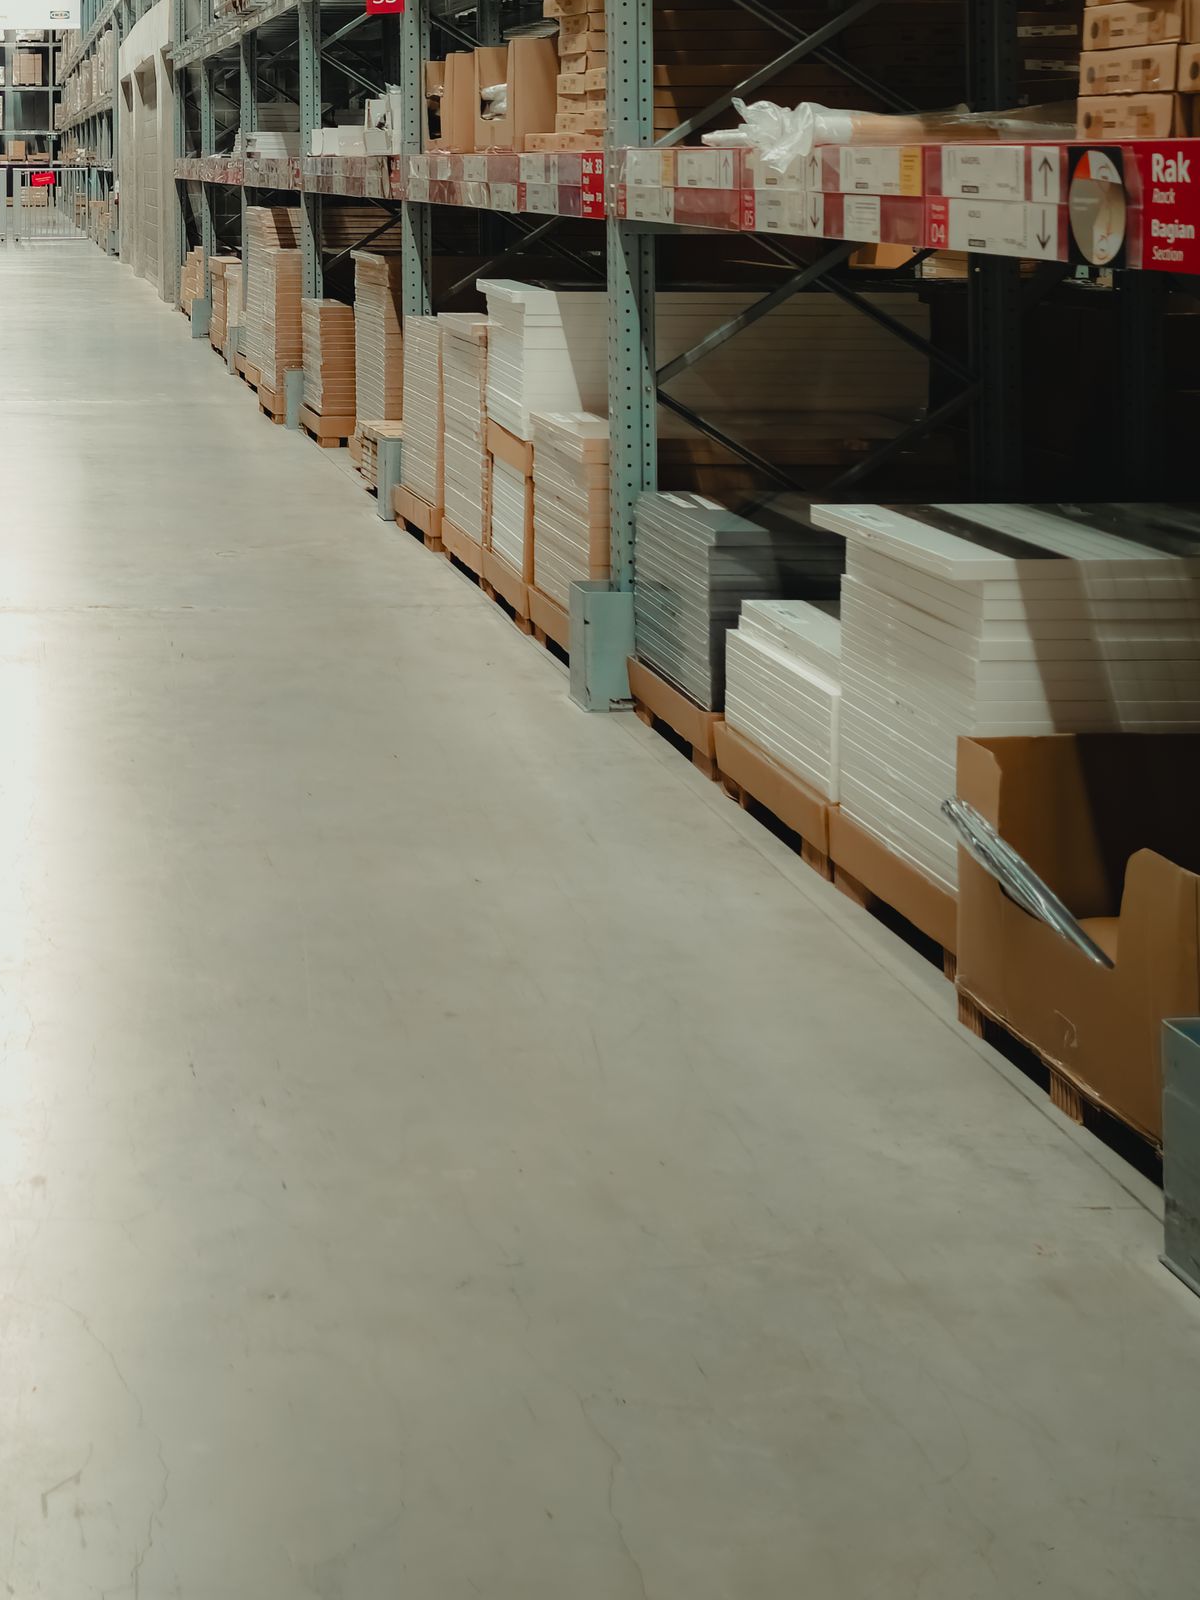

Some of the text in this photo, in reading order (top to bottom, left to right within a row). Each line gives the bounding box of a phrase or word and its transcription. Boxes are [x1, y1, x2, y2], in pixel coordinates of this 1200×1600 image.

[1151, 150, 1192, 184] Rak
[1151, 187, 1176, 204] Rack
[930, 222, 946, 244] 04
[1150, 218, 1196, 244] Bagian
[1151, 245, 1185, 262] Section
